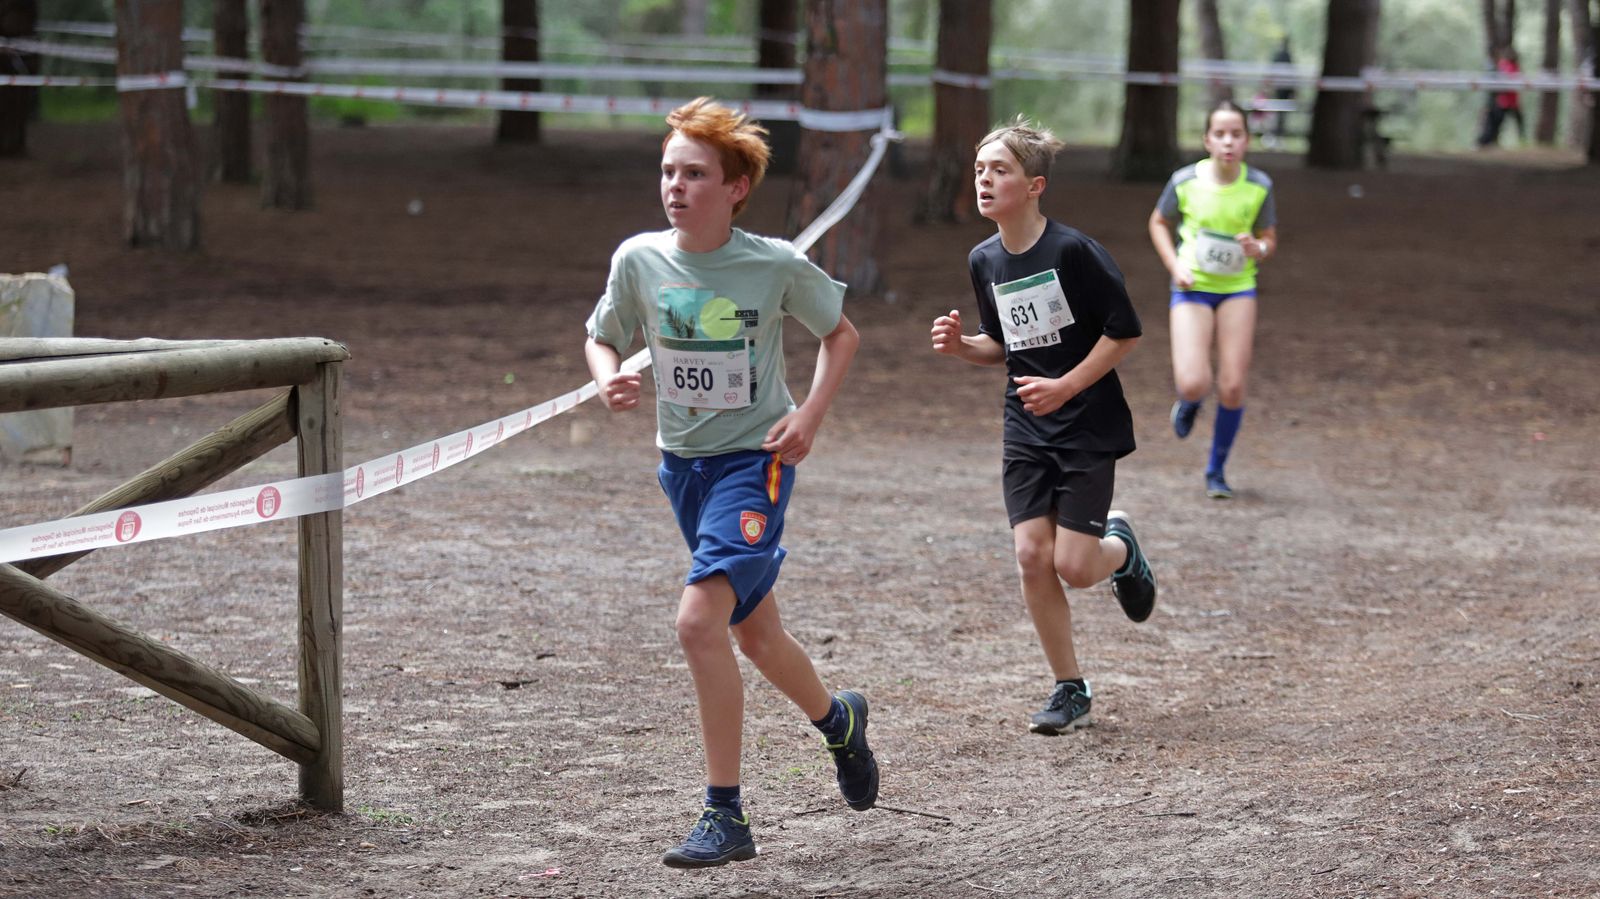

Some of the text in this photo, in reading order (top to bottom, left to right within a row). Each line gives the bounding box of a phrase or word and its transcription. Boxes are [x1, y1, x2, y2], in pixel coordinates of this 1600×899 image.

[1010, 302, 1038, 326] 631
[673, 357, 706, 366] HARVEY
[674, 366, 713, 391] 650
